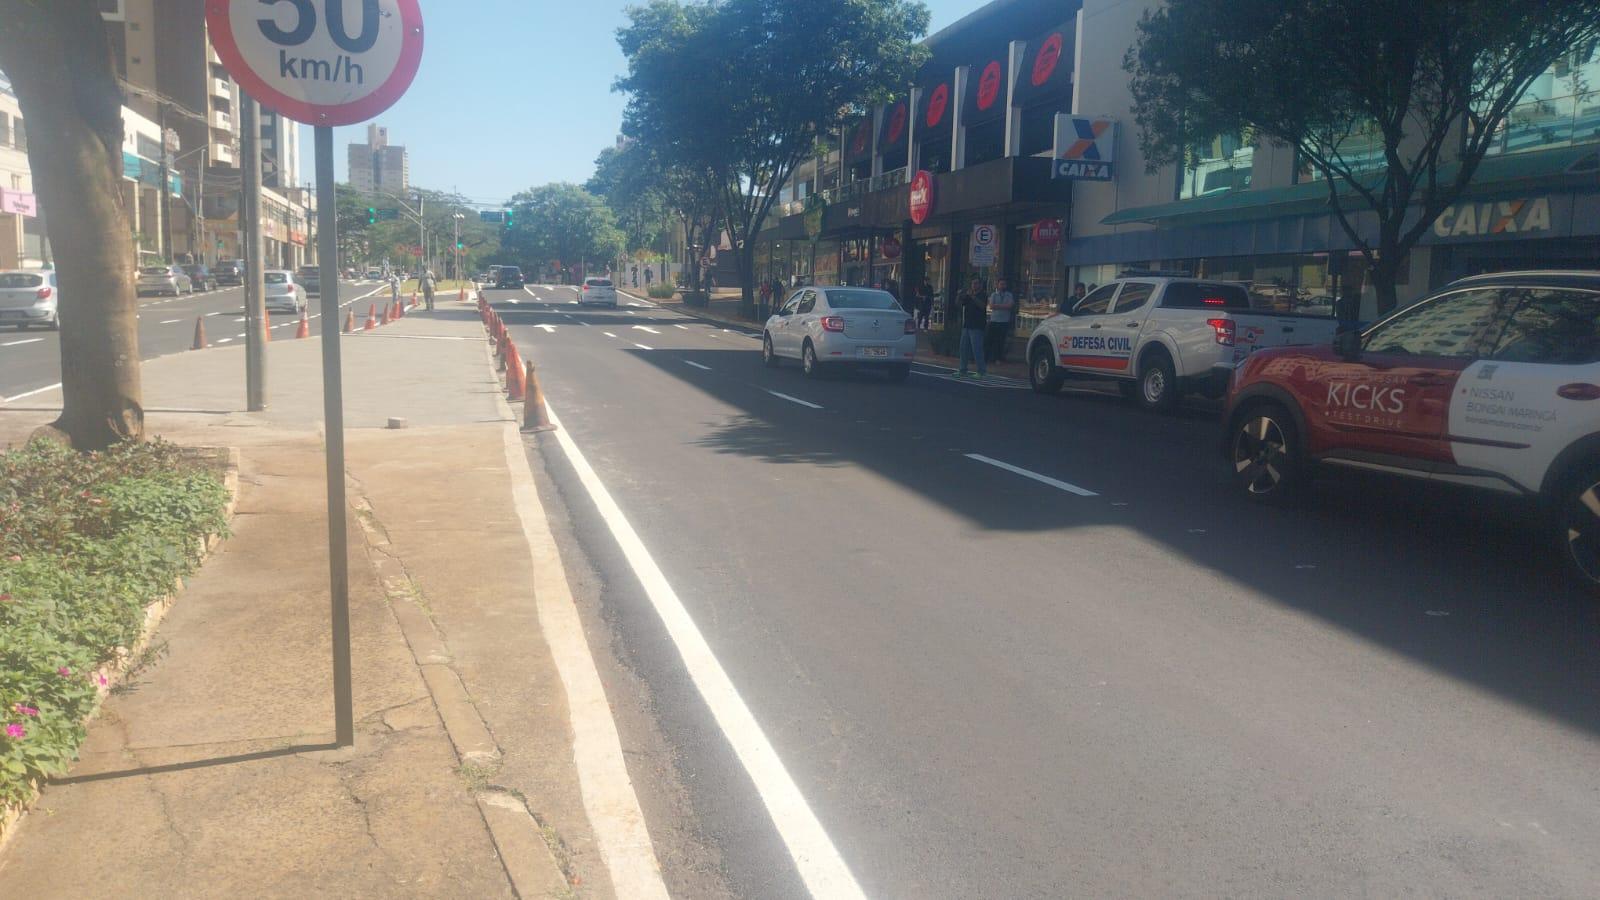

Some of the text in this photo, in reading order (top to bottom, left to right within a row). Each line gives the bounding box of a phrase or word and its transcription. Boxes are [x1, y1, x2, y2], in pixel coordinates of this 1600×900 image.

[257, 0, 380, 53] 50
[279, 50, 364, 84] km/h
[1059, 162, 1109, 178] CAIXA
[1434, 197, 1550, 237] CAIXA
[980, 229, 989, 241] E
[1040, 223, 1059, 238] mix
[1072, 336, 1131, 351] DEFESA CIVIL
[1327, 381, 1406, 415] KICKS
[1470, 387, 1515, 402] NISSAN
[1333, 410, 1361, 422] TEST
